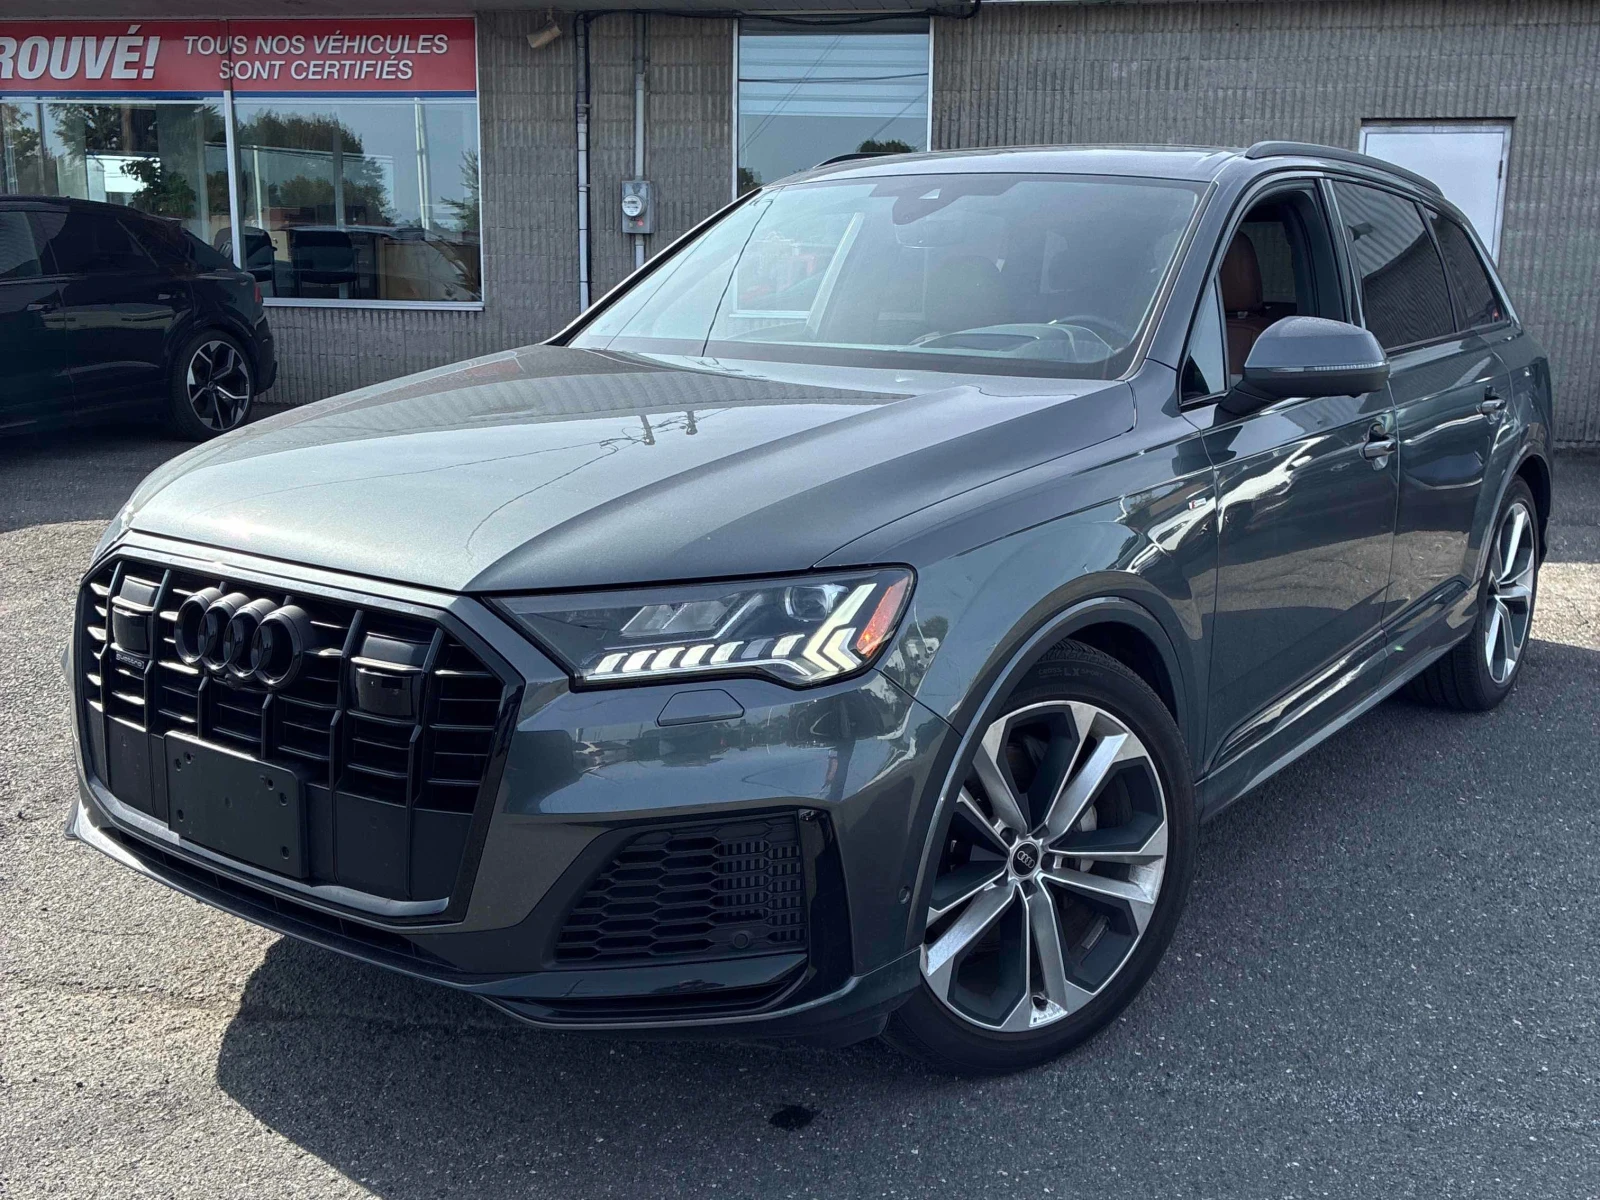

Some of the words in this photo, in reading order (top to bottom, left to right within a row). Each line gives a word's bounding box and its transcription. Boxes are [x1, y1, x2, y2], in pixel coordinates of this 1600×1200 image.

[0, 25, 161, 79] ROUVÉ!
[183, 36, 247, 55] TOUS
[254, 35, 305, 55] NOS
[313, 30, 448, 54] VÉHICULES
[219, 60, 286, 80] SONT
[290, 56, 413, 80] CERTIFIÉS
